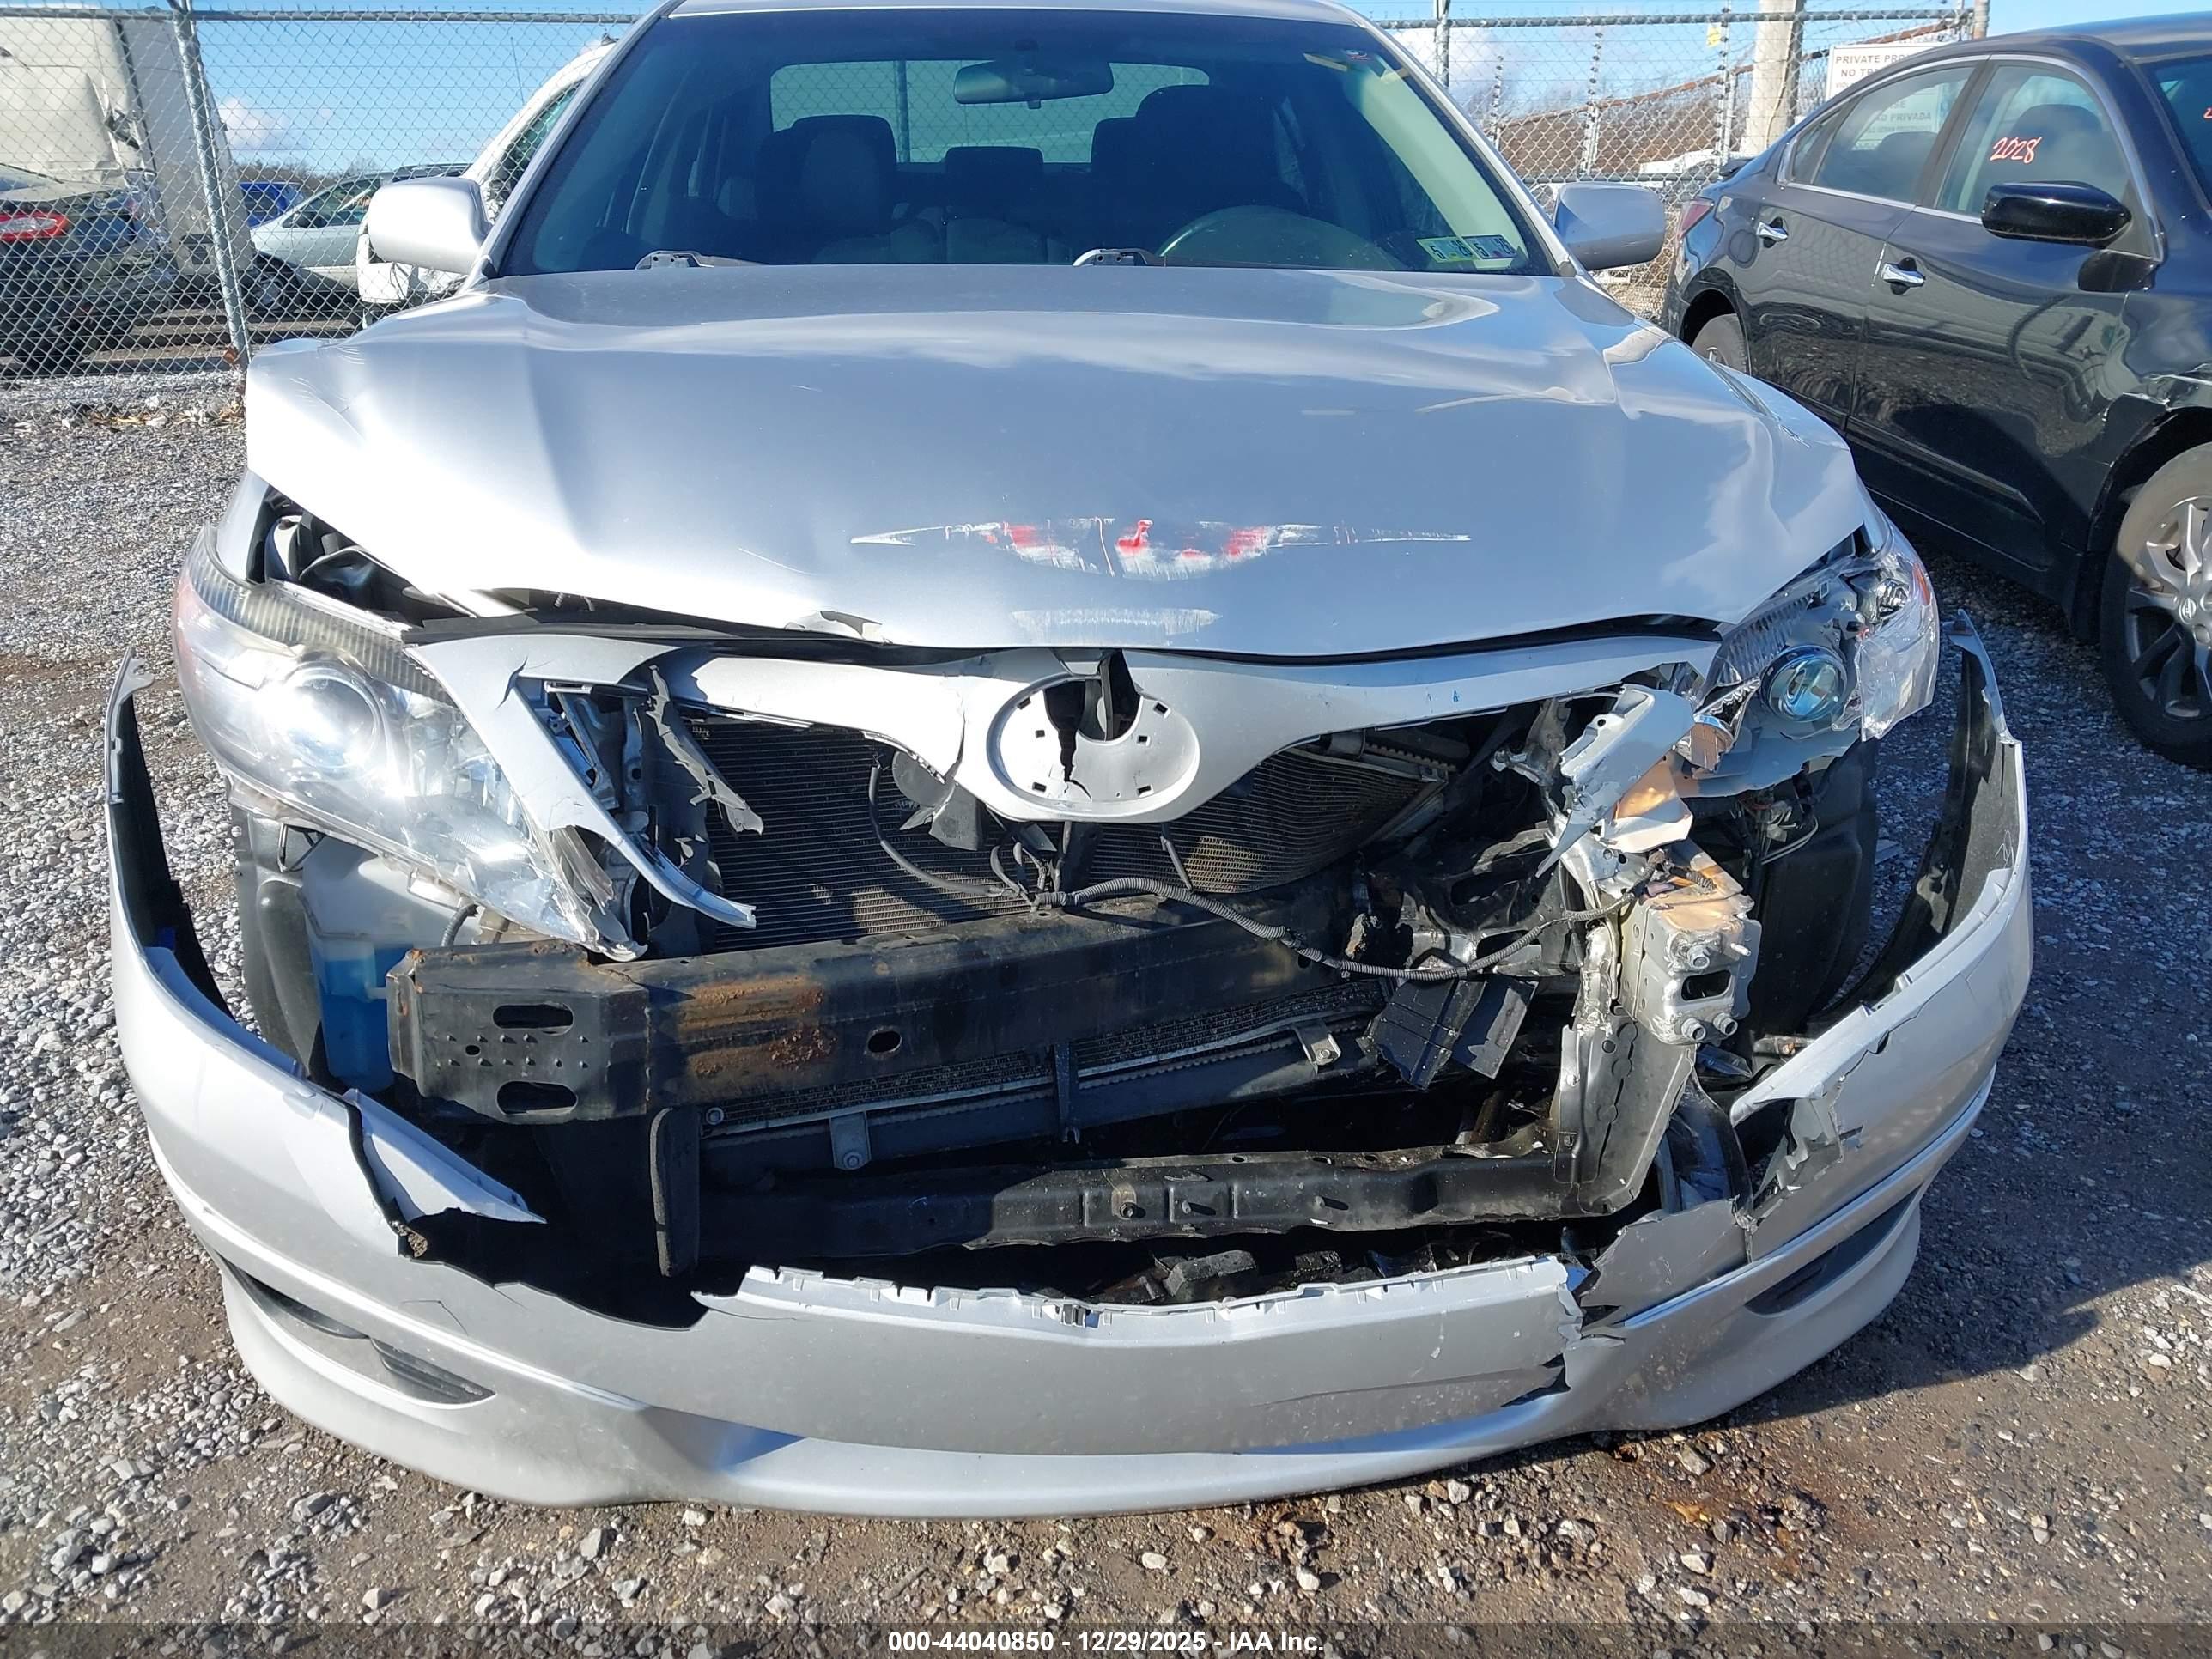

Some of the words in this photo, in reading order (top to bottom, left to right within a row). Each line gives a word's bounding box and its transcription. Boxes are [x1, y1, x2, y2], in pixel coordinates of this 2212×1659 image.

[1835, 55, 1881, 64] PRIVATE
[1840, 69, 1856, 77] NO
[1990, 137, 2042, 164] 2028
